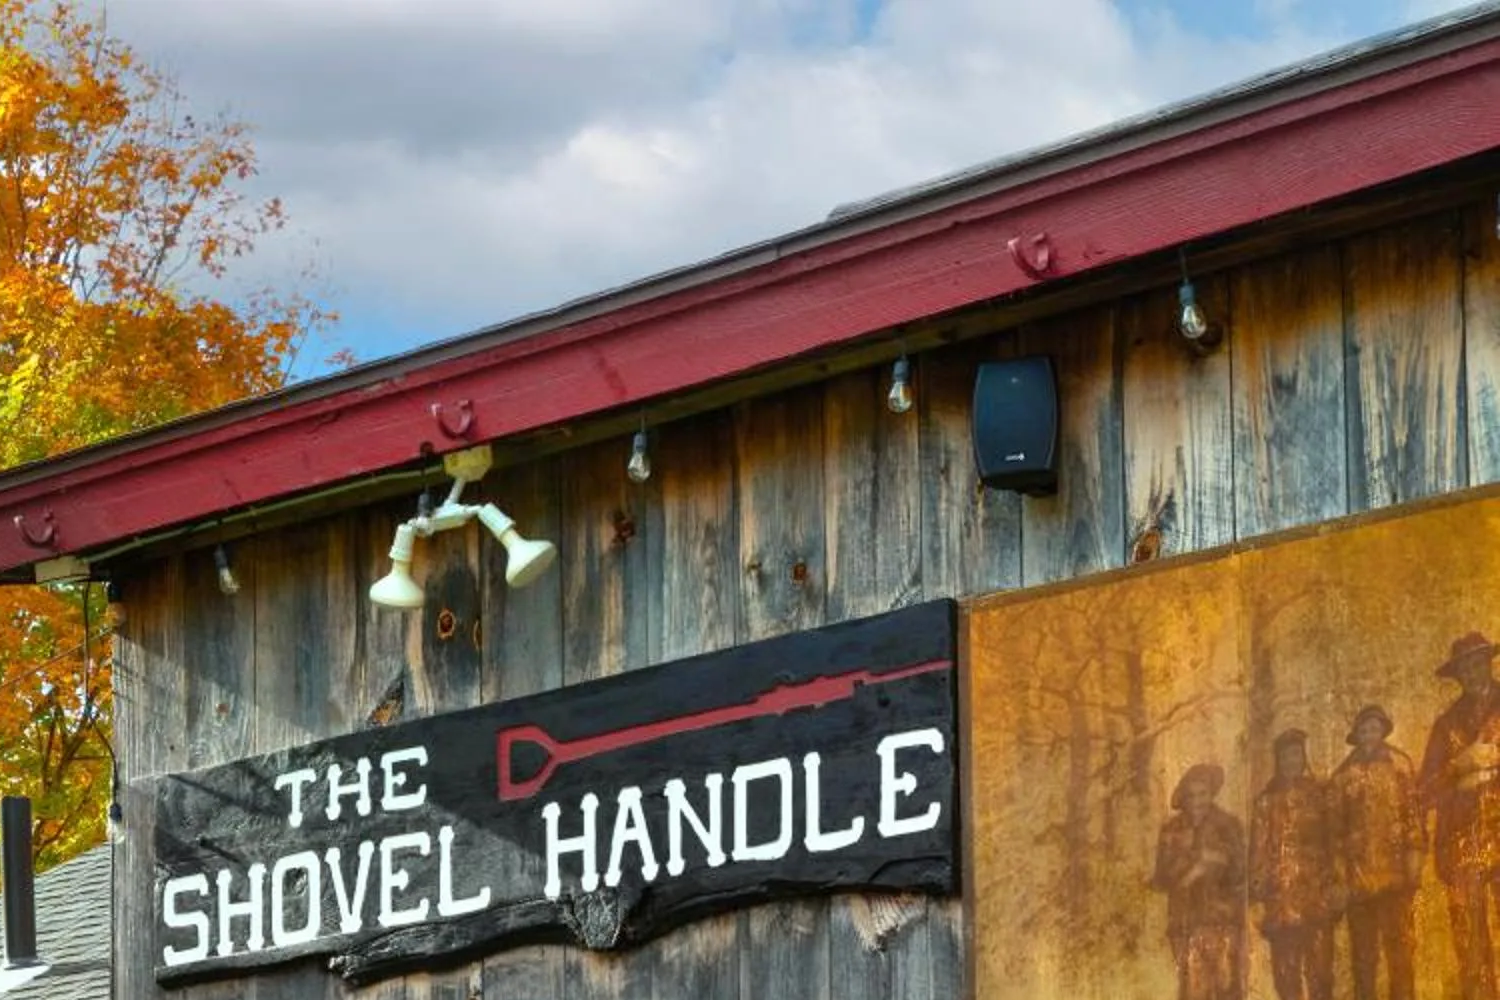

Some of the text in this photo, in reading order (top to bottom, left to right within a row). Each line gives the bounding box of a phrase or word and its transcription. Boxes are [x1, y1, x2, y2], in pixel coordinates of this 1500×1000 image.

[162, 727, 945, 967] SHOVEL HANDLE
[273, 746, 429, 829] THE
